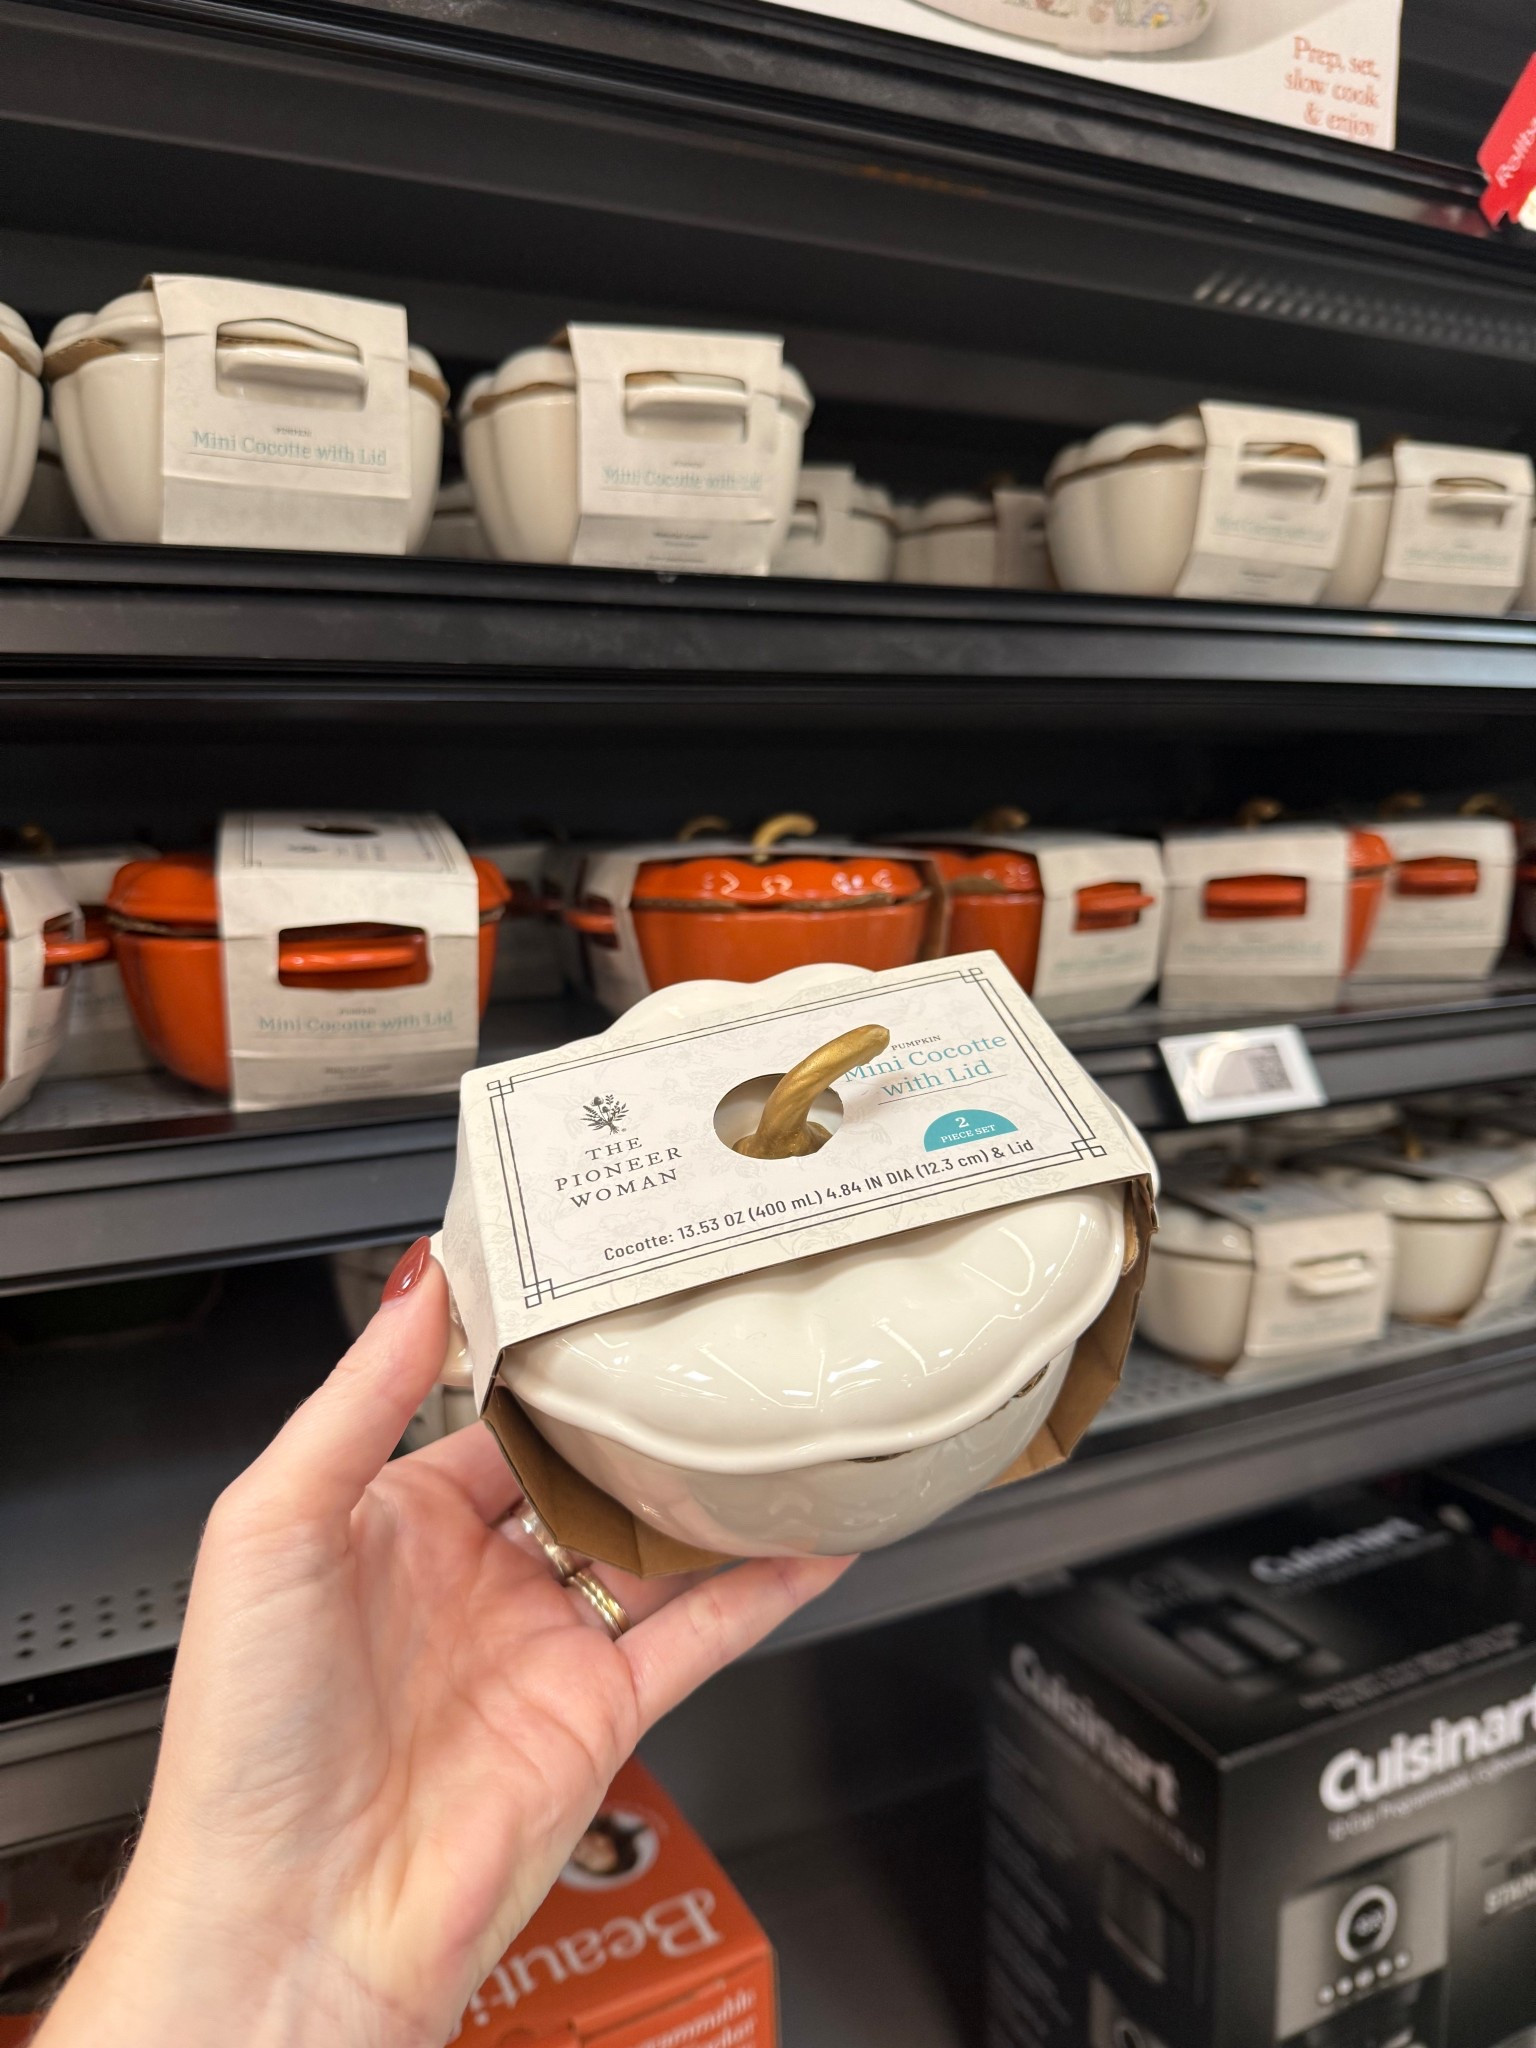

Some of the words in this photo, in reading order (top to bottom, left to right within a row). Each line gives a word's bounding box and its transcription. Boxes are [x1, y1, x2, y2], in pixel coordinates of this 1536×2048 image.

[1285, 67, 1328, 94] slow
[192, 430, 236, 449] Mini
[242, 436, 312, 459] Cocotte
[316, 444, 355, 464] with
[359, 448, 387, 466] Lid
[259, 1015, 300, 1032] Mini
[306, 1016, 374, 1034] Cocotte
[891, 1034, 942, 1051] PUMPKIN
[845, 1055, 905, 1083] Mini
[908, 1035, 1008, 1067] Cocotte
[881, 1071, 945, 1097] with
[945, 1059, 993, 1083] Lid
[940, 1130, 975, 1144] PIECE
[975, 1124, 996, 1137] SET
[954, 1115, 970, 1129] 2
[584, 1137, 643, 1161] THE
[554, 1147, 683, 1192] PIONEER
[570, 1168, 677, 1208] WOMAN
[604, 1232, 674, 1262] Cocotte:
[677, 1217, 720, 1241] 13.53
[723, 1210, 746, 1228] OZ
[748, 1199, 787, 1222] (400
[791, 1189, 823, 1211] mL)
[826, 1181, 862, 1200] 4.84
[864, 1175, 884, 1191] IN
[888, 1167, 914, 1185] DIA
[916, 1158, 954, 1179] (12.3
[957, 1148, 990, 1168] cm)
[992, 1146, 1005, 1159] &
[1009, 1139, 1035, 1155] Lid
[1250, 1515, 1427, 1584] Cuisinart
[1010, 1644, 1180, 1818] Cuisinart
